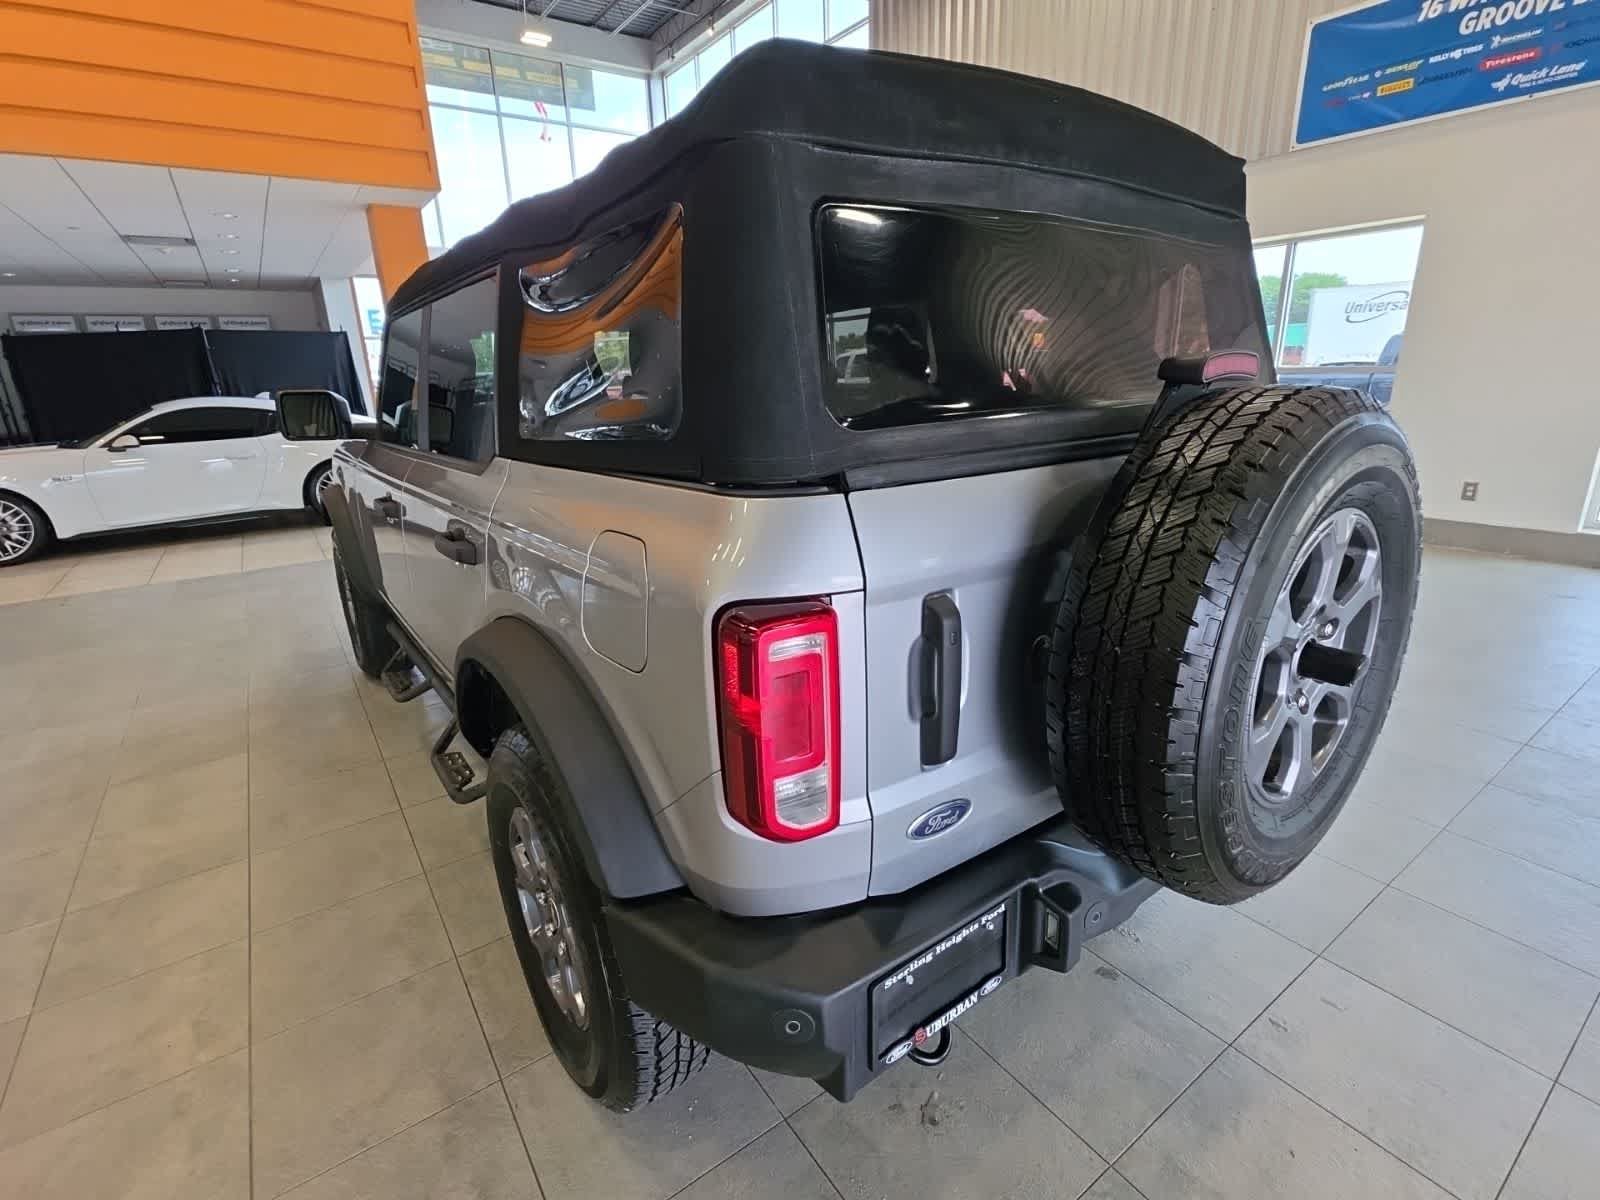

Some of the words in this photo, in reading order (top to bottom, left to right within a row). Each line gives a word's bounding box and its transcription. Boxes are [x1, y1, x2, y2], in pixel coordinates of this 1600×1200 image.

[1417, 0, 1443, 22] 16
[1459, 0, 1578, 35] GROOVE
[1511, 67, 1549, 86] Quick
[1549, 60, 1588, 76] Lane
[884, 953, 933, 990] Sterling
[935, 923, 979, 954] Heights
[981, 904, 1006, 925] Ford
[914, 993, 979, 1045] SUBURBAN
